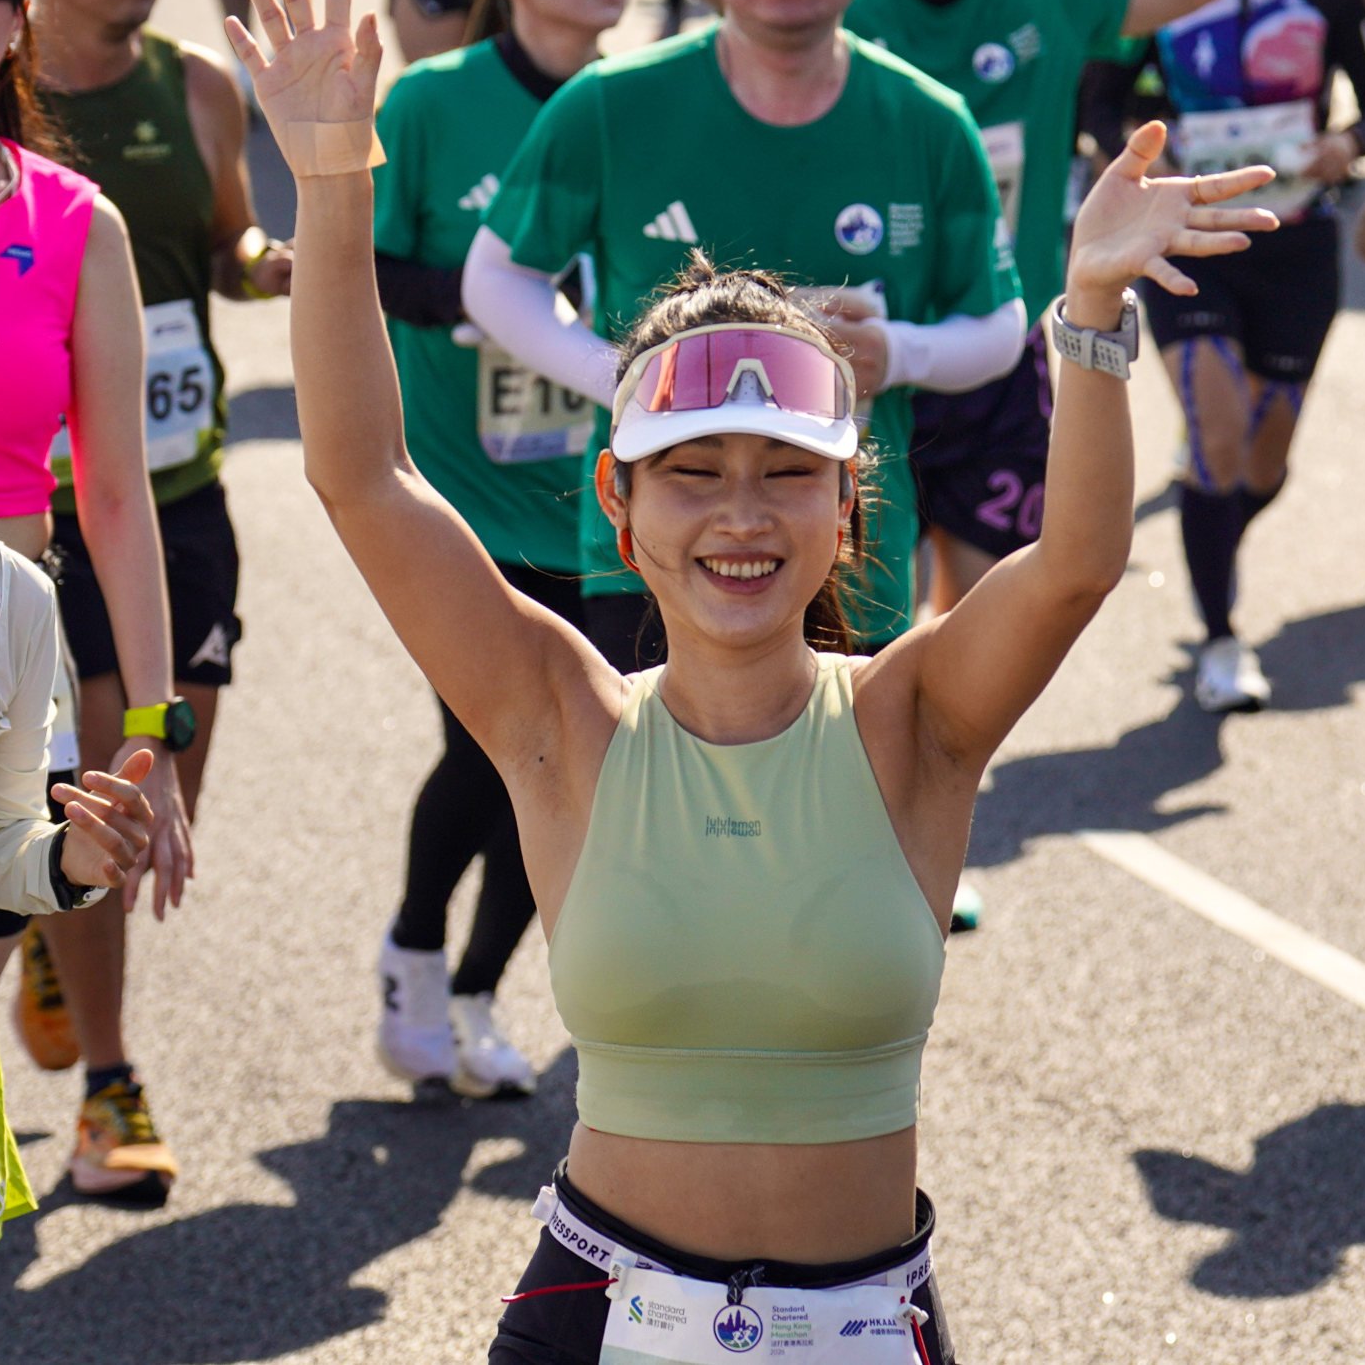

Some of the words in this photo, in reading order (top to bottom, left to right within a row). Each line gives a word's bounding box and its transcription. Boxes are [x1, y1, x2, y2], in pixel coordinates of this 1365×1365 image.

[148, 364, 205, 421] 65
[648, 1301, 685, 1316] standard
[772, 1305, 805, 1313] Standard
[647, 1309, 687, 1324] chartered
[771, 1313, 809, 1321] Chartered
[869, 1317, 897, 1327] HKAAA
